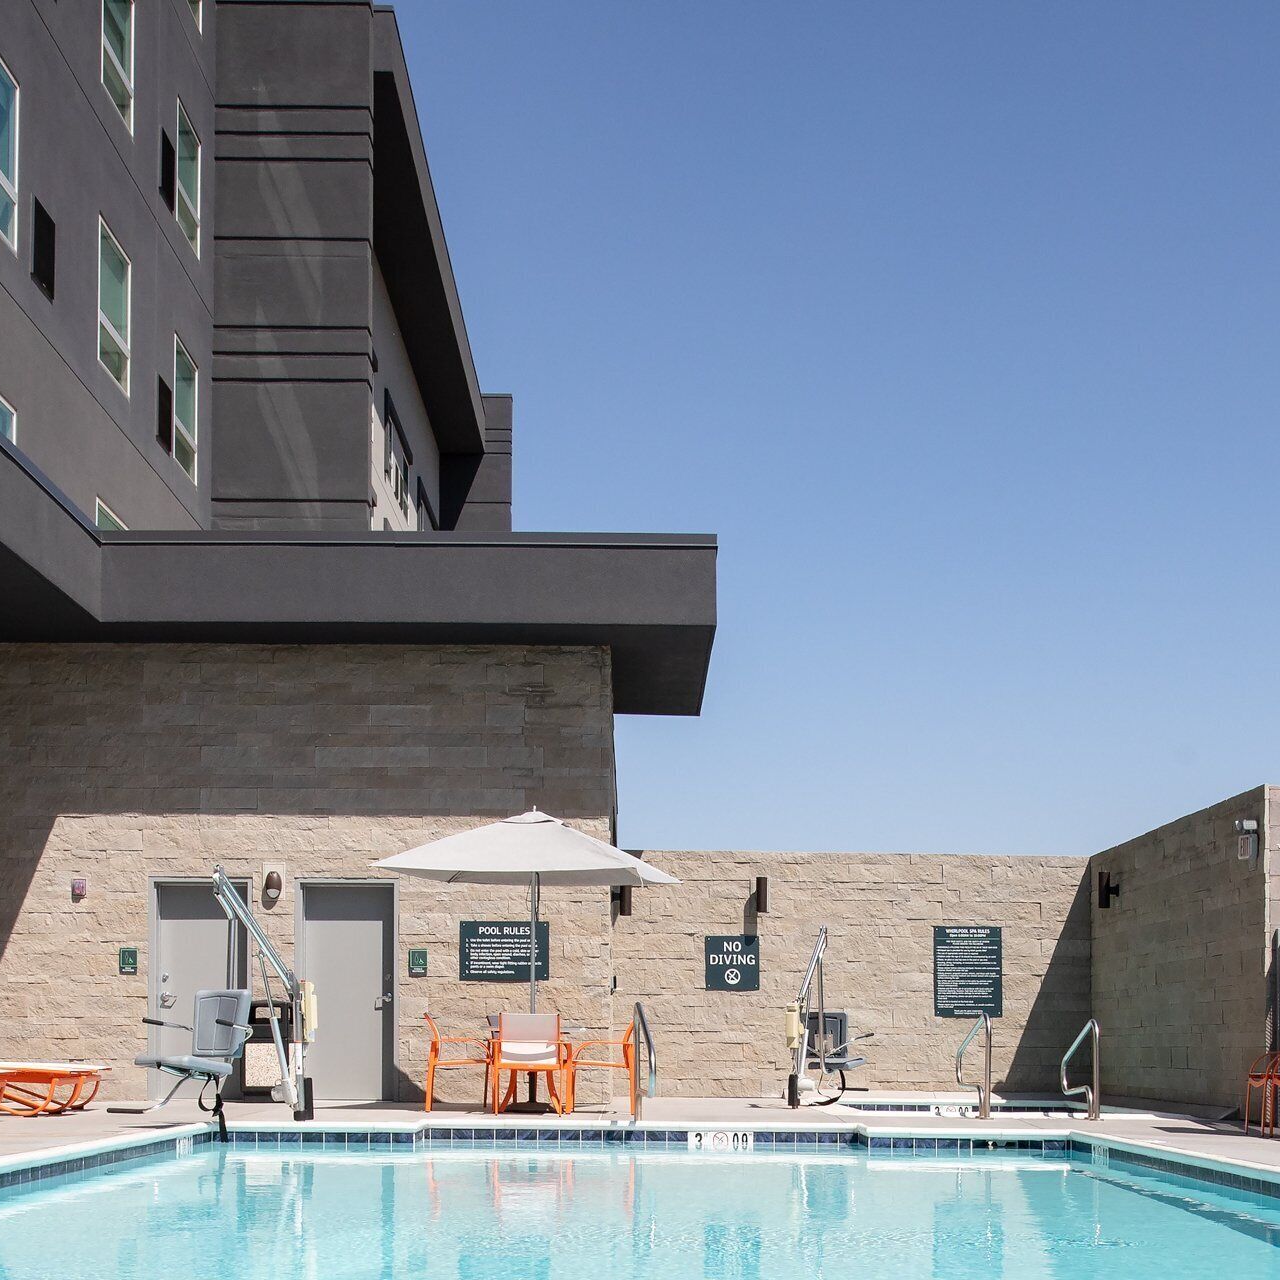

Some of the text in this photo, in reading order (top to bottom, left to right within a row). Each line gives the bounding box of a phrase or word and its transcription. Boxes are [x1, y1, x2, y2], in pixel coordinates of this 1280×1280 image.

[478, 926, 531, 935] POOL RULES
[723, 941, 742, 952] NO
[710, 954, 756, 965] DIVING
